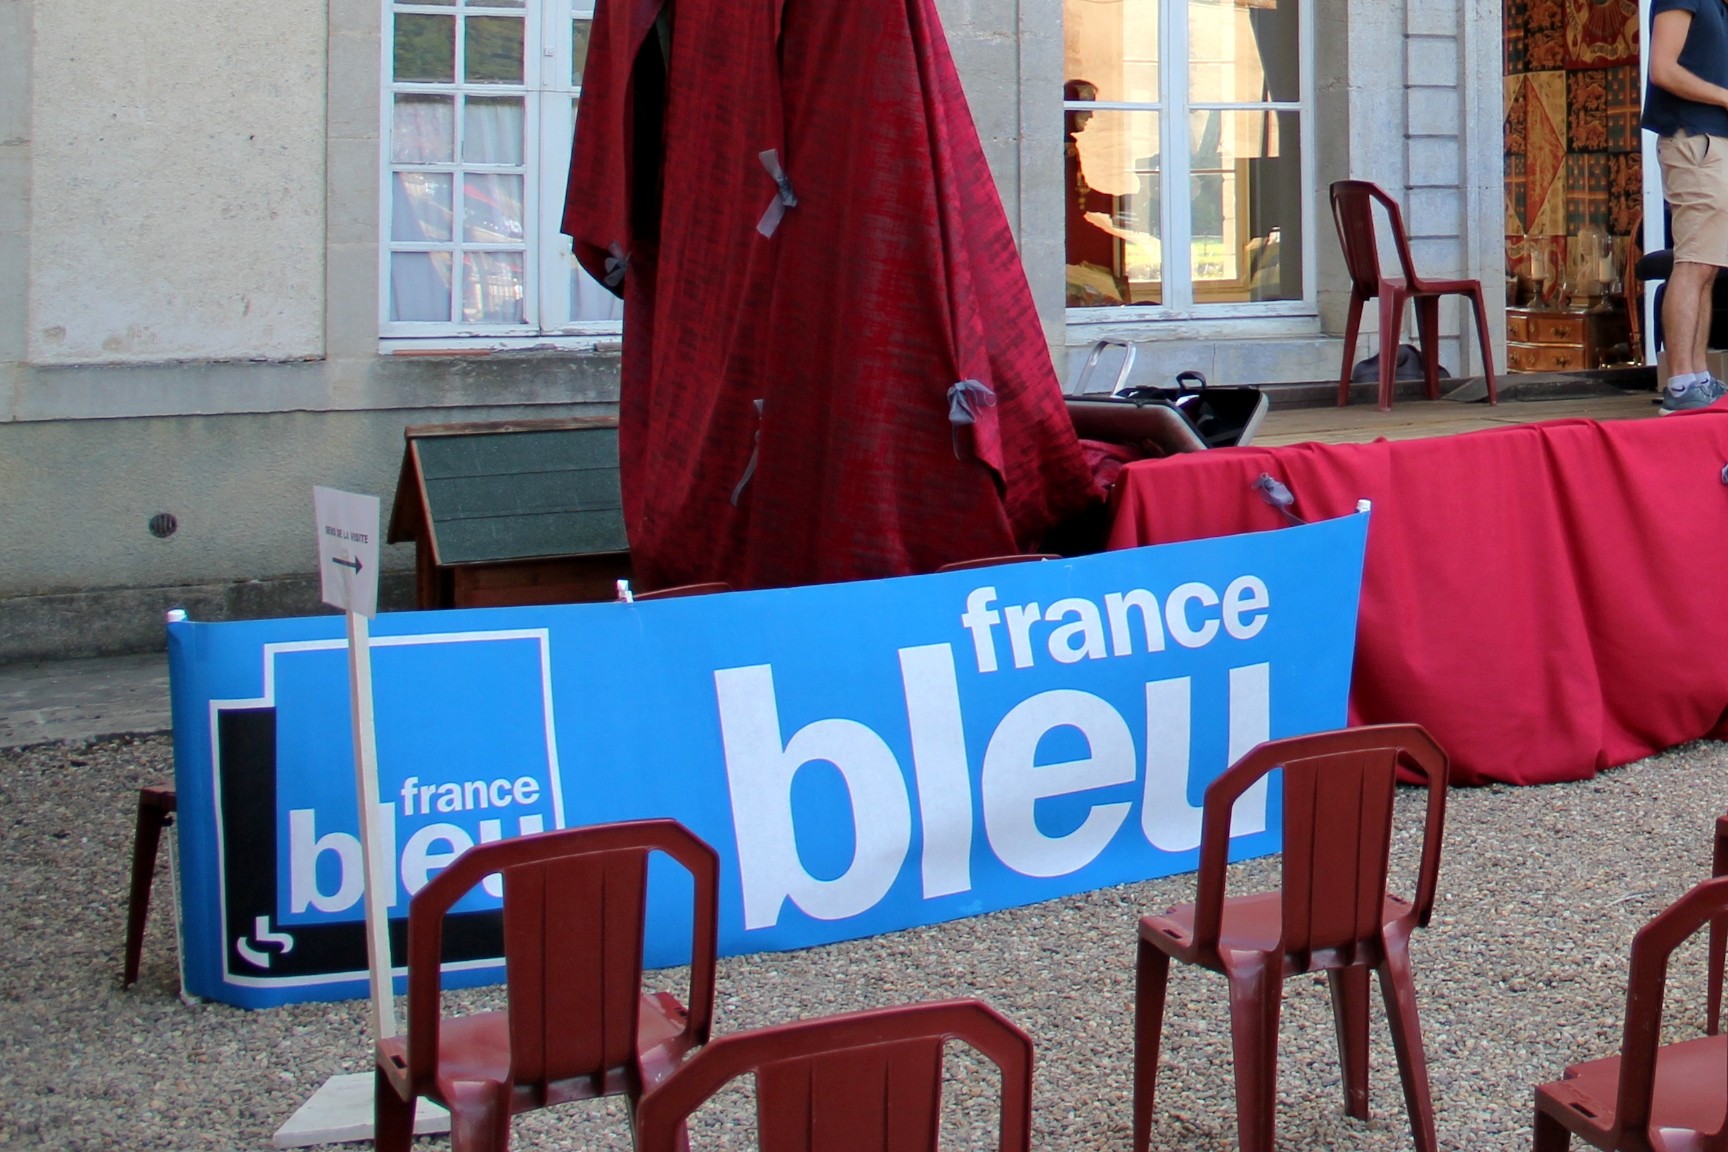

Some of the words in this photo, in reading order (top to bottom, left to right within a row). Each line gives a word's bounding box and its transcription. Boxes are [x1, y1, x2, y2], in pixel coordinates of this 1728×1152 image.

[350, 532, 368, 544] VISITE
[961, 574, 1270, 674] france
[401, 776, 540, 816] france
[713, 642, 1271, 931] bleu
